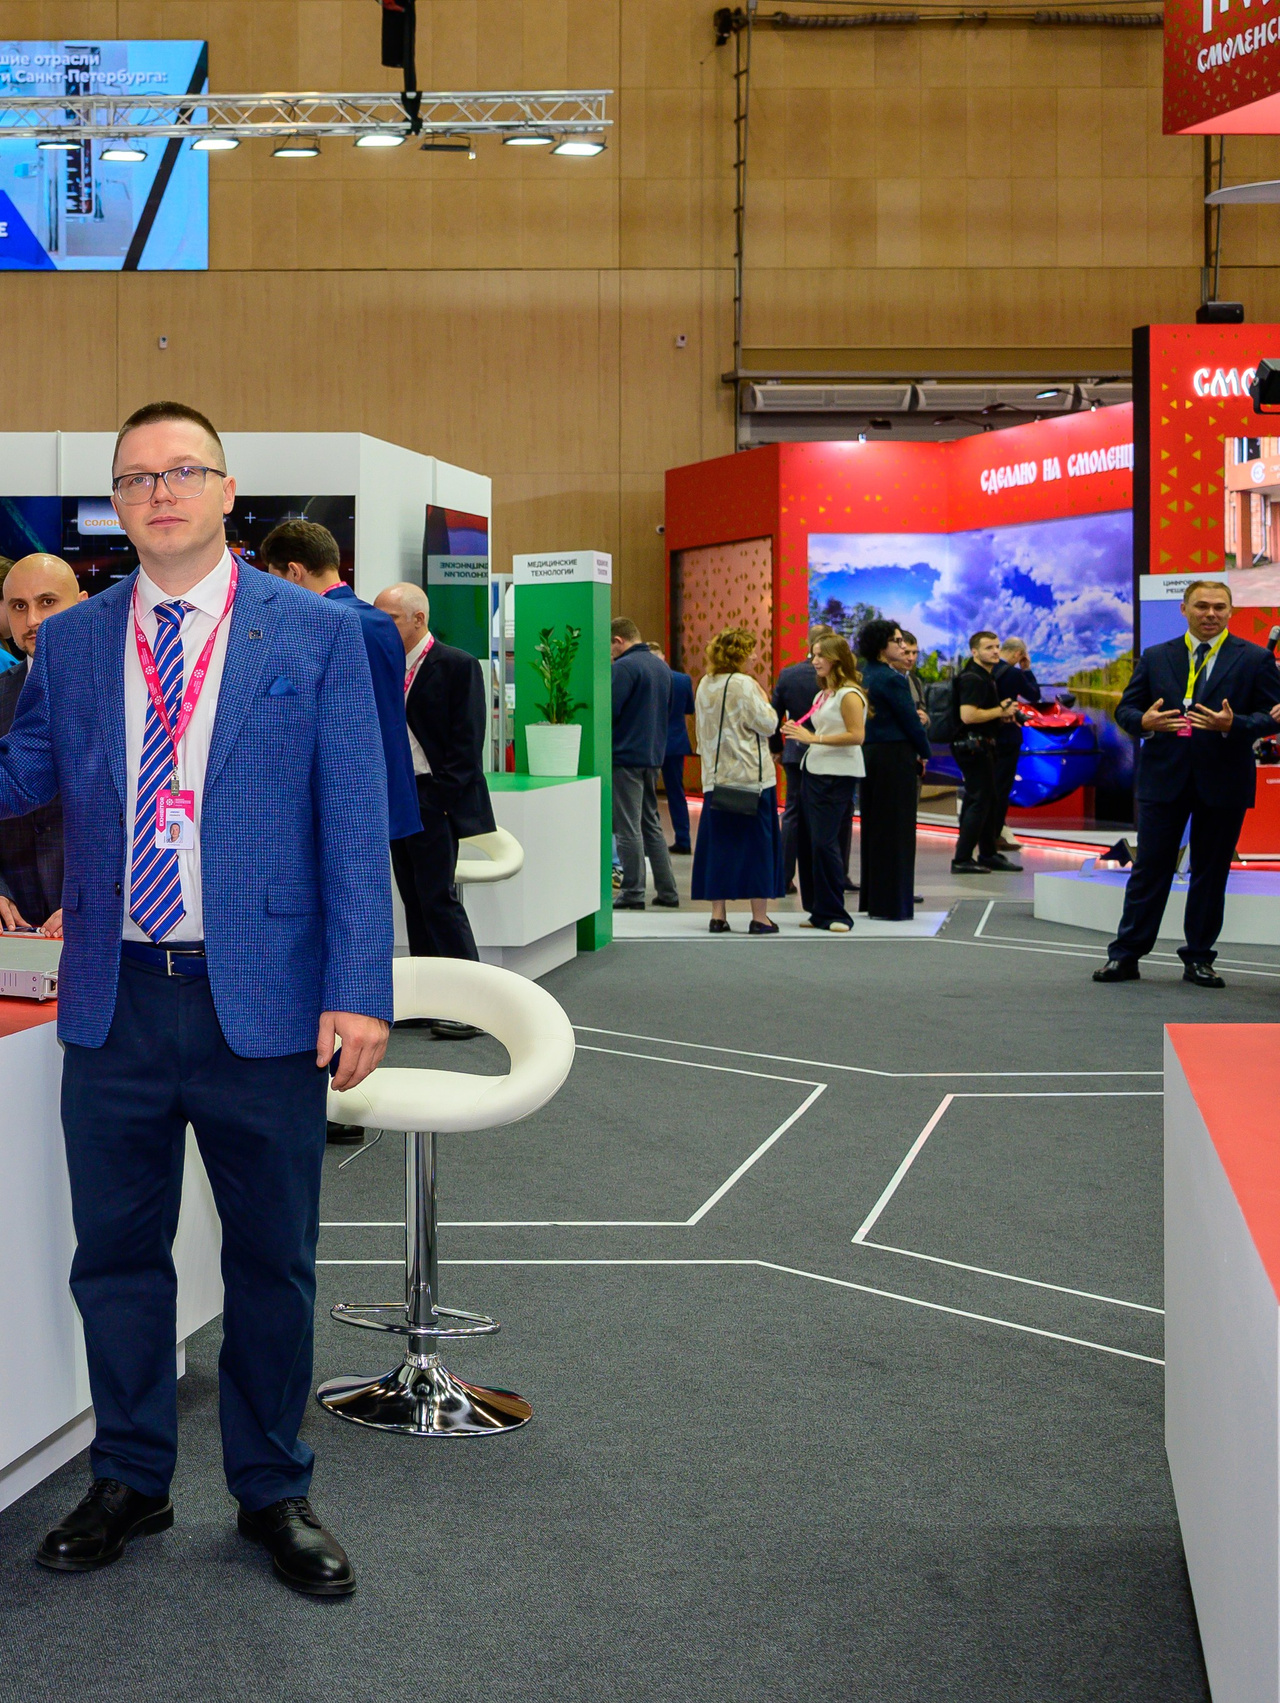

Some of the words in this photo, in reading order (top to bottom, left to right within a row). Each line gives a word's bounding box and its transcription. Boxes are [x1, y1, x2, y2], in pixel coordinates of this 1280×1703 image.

[34, 53, 100, 68] отрасли
[15, 69, 168, 85] Санкт-Петербурга:
[980, 461, 1037, 495] СДЕЛАНО
[1042, 457, 1062, 482] НА
[527, 558, 578, 568] МЕДИЦИНСКИЕ
[531, 568, 574, 577] ТЕХНОЛОГИИ
